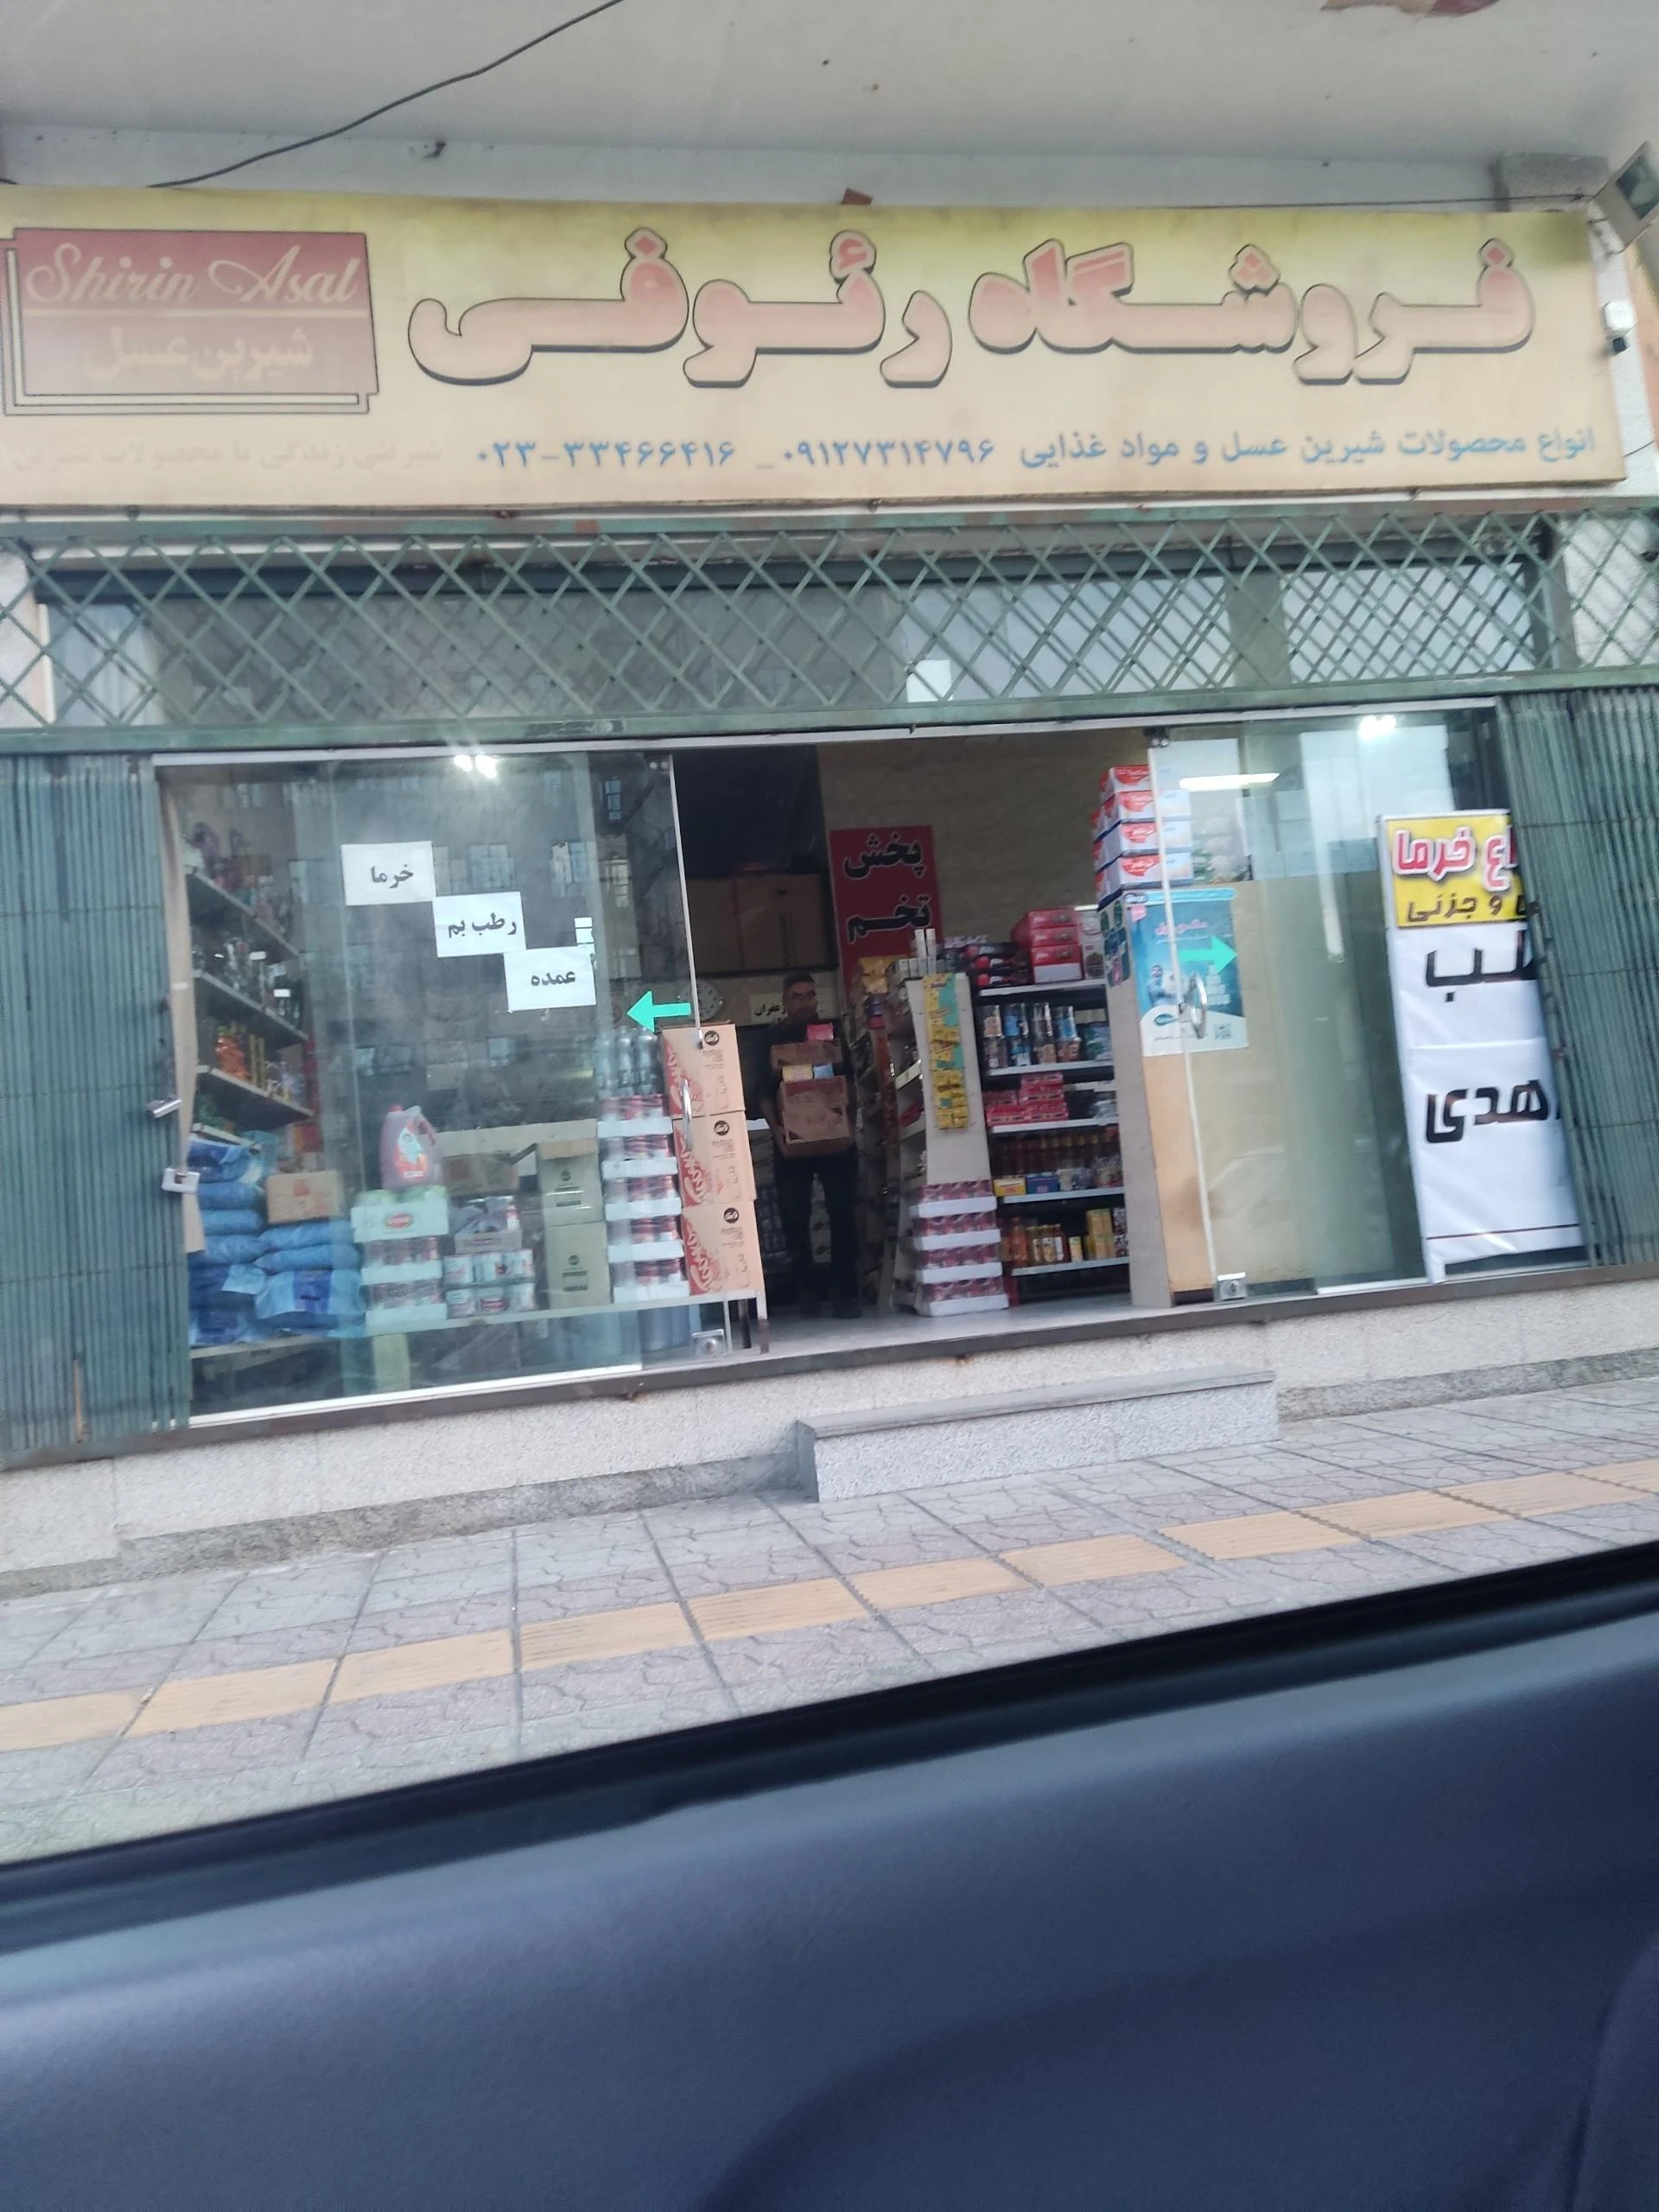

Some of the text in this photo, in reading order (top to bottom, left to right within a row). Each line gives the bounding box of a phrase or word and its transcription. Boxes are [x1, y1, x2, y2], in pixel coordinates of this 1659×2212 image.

[26, 243, 361, 305] Shirin Asal
[408, 227, 1535, 387] فروشگاه رئوفی
[84, 326, 314, 382] شیرین عسل
[784, 439, 995, 467] ۰۹۱۲۷۳۱۴۷۹۶
[1020, 431, 1107, 468] غذایی
[1120, 432, 1179, 466] مواد
[1192, 441, 1210, 464] و
[1222, 430, 1287, 462] عسل
[1301, 429, 1386, 464] شیرین
[1397, 429, 1527, 462] محصولات
[1538, 427, 1595, 462] انواع
[843, 830, 925, 880] پخش
[1393, 827, 1476, 881] خرما
[371, 863, 414, 888] خرما
[846, 893, 932, 944] تخم
[1489, 894, 1503, 915] و
[448, 912, 516, 938] رطب بم
[530, 969, 576, 987] عمده
[1426, 1080, 1560, 1143] هدی
